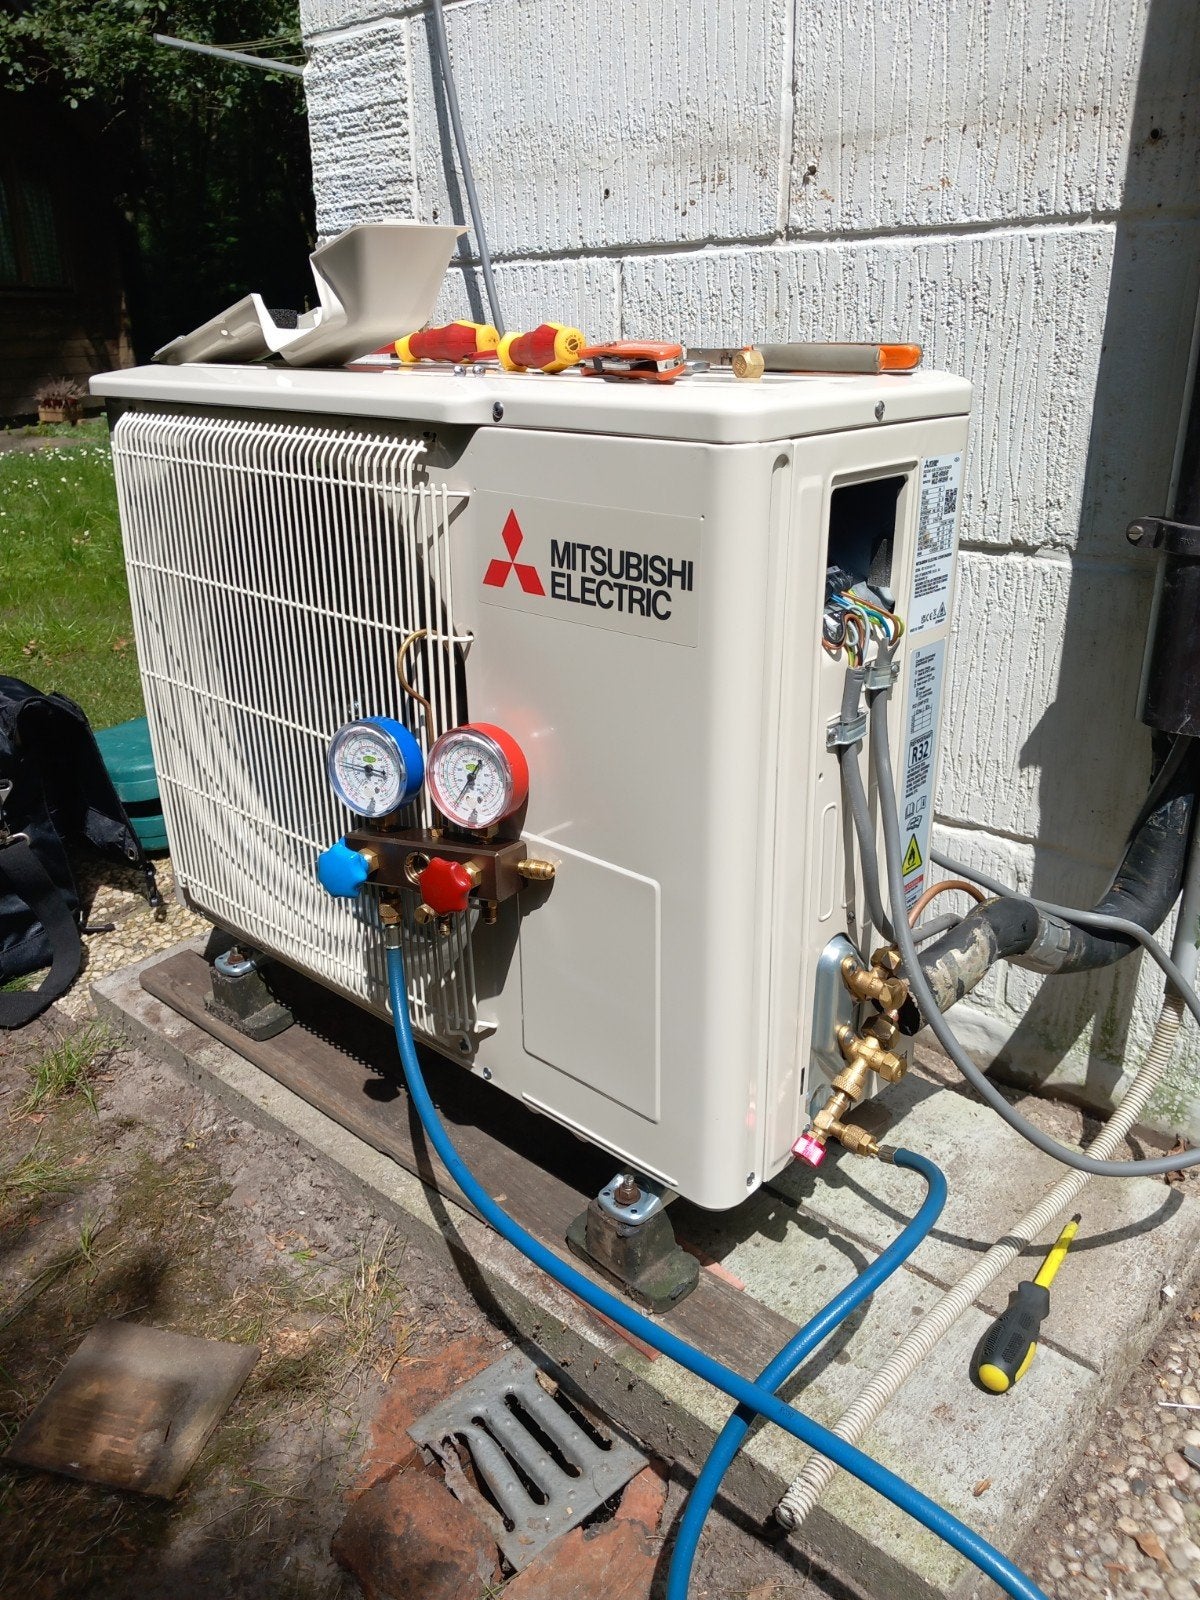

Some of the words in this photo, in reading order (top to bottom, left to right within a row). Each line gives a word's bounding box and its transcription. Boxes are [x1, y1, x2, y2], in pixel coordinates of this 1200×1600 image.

[550, 539, 693, 591] MITSUBISHI
[551, 571, 672, 621] ELECTRIC
[912, 740, 929, 764] R32
